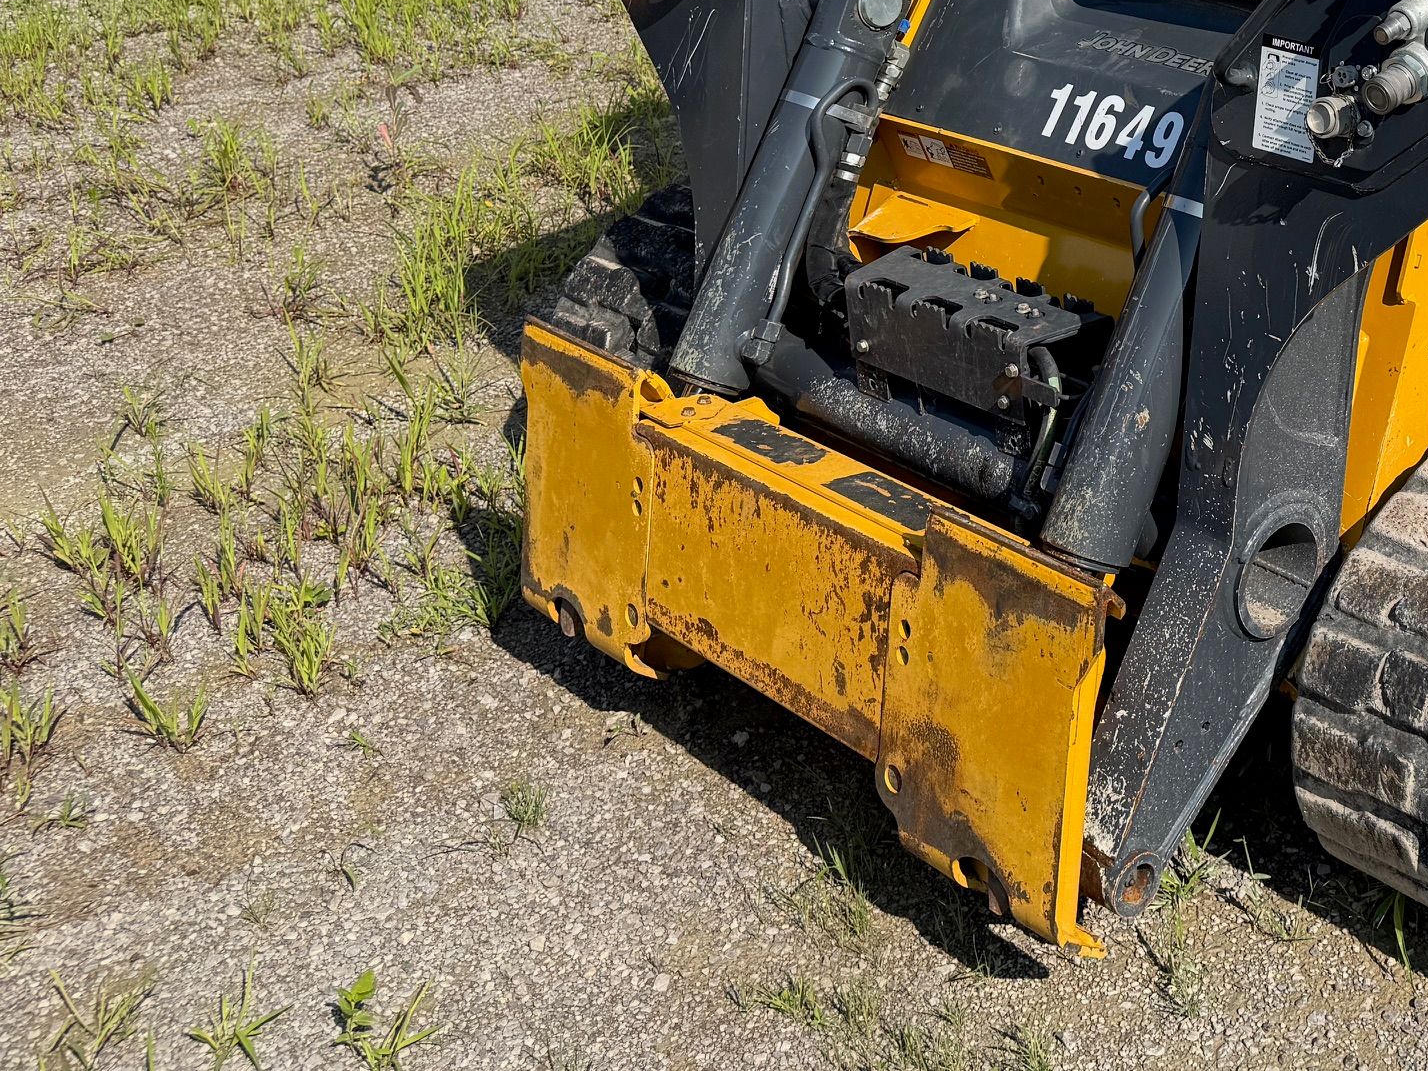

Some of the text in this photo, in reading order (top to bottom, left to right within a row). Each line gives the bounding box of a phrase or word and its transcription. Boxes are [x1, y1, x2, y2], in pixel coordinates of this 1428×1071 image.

[1077, 30, 1215, 78] JOHN DEER
[1272, 37, 1315, 56] IMPORTANT
[1041, 83, 1185, 169] 11649
